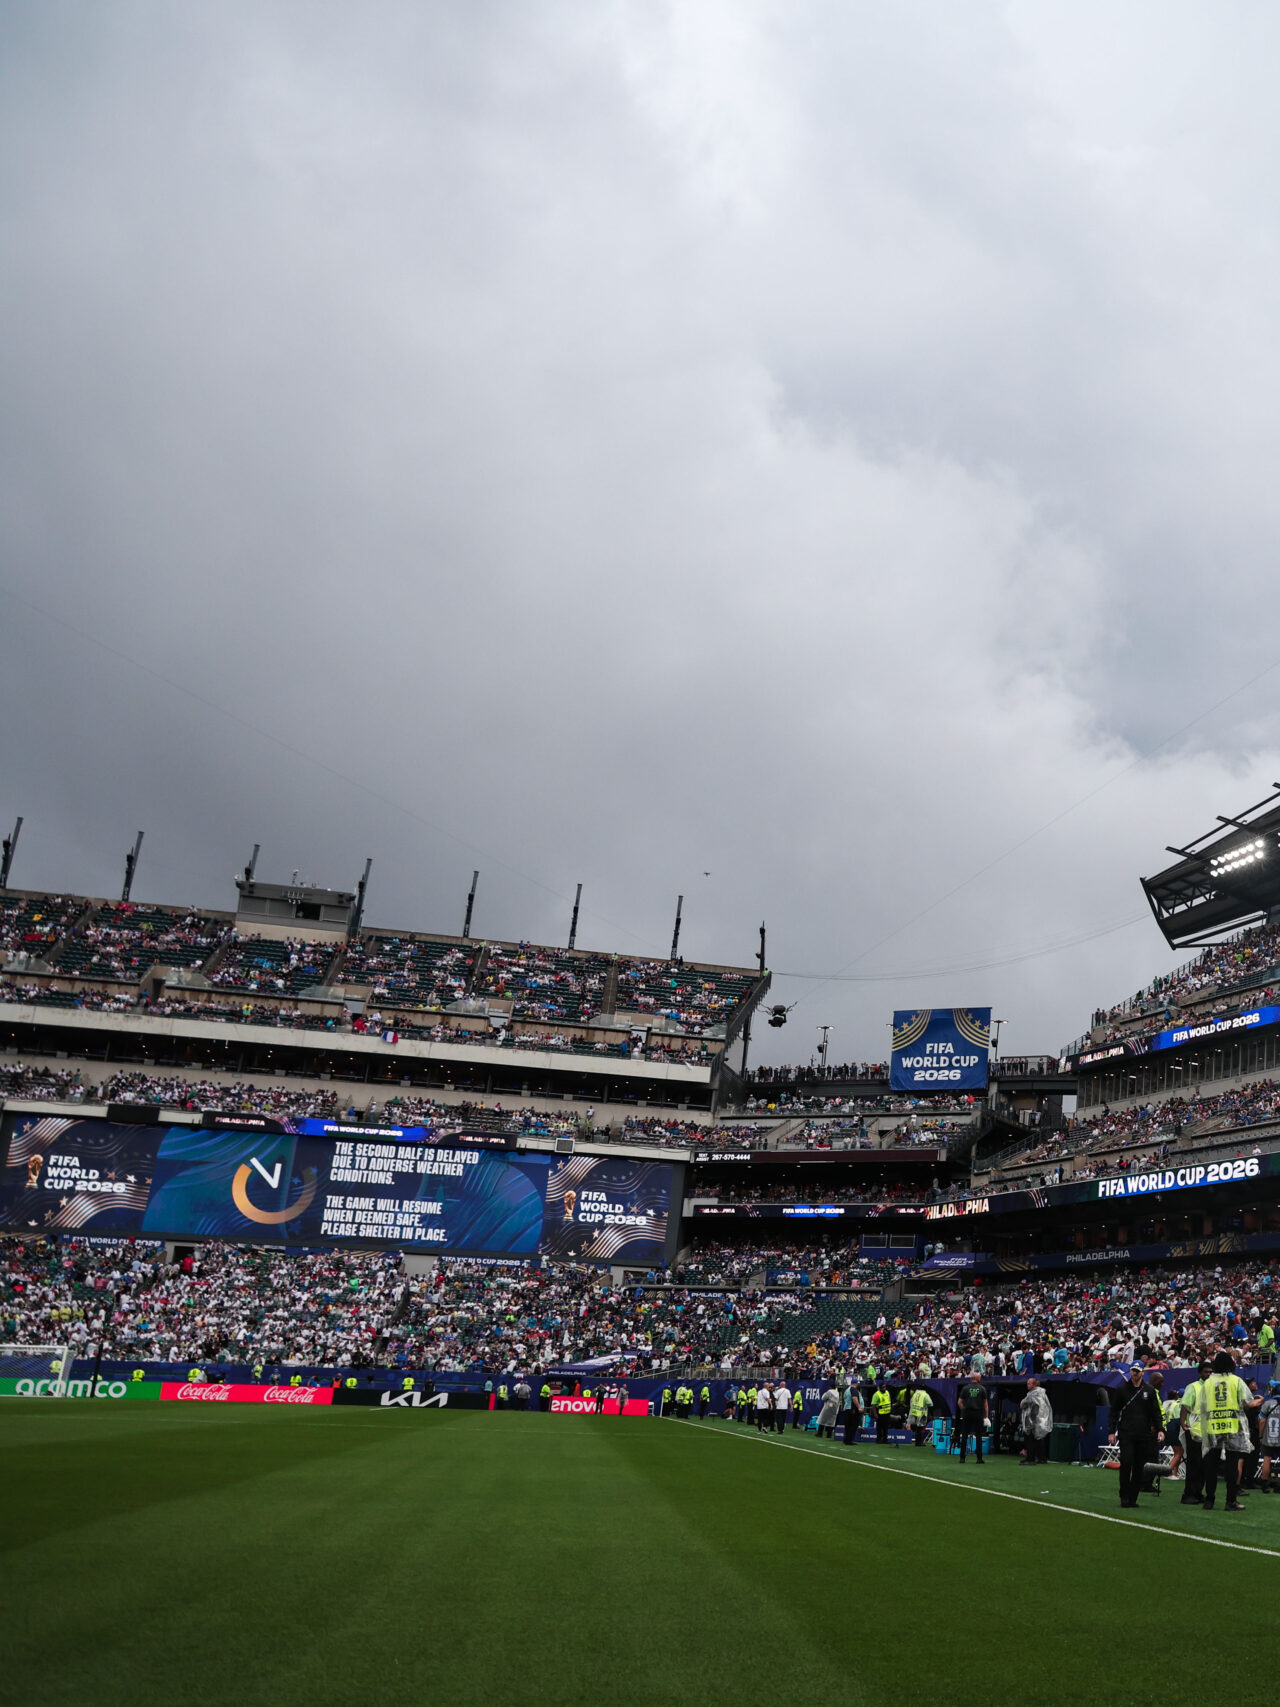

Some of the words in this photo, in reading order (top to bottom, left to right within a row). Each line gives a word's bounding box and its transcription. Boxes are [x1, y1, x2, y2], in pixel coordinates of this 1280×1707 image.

[1173, 1030, 1189, 1042] FIFA
[1189, 1024, 1215, 1039] WORLD
[1216, 1021, 1232, 1033] CUP
[1232, 1013, 1260, 1028] 2026
[925, 1042, 954, 1054] FIFA
[901, 1056, 950, 1068] WORLD
[952, 1055, 979, 1067] CUP
[913, 1069, 961, 1081] 2026
[340, 1126, 363, 1134] WORLD
[458, 1135, 505, 1144] PHILADPHIA
[335, 1142, 354, 1155] THE
[355, 1144, 396, 1158] SECOND
[397, 1146, 423, 1160] HALF
[424, 1148, 434, 1161] IS
[436, 1149, 480, 1164] DELAYED
[49, 1155, 80, 1167] FIFA
[332, 1155, 352, 1168] DUE
[354, 1156, 367, 1169] TO
[368, 1157, 416, 1173] ADVERSE
[416, 1161, 464, 1176] WEATHER
[47, 1167, 99, 1179] WORLD
[330, 1168, 395, 1185] CONDITIONS.
[1098, 1178, 1125, 1197] FIFA
[1126, 1170, 1175, 1194] WORLD
[1176, 1166, 1205, 1187] CUP
[1207, 1158, 1260, 1182] 2026
[44, 1178, 74, 1190] CUP
[74, 1181, 126, 1193] 2026
[581, 1191, 607, 1202] FIFA
[326, 1195, 345, 1208] THE
[345, 1196, 376, 1210] GAME
[376, 1198, 400, 1212] WILL
[402, 1200, 443, 1215] RESUME
[579, 1202, 624, 1213] WORLD
[323, 1208, 353, 1222] WHEN
[354, 1210, 395, 1225] DEEMED
[395, 1213, 423, 1227] SAFE.
[578, 1213, 604, 1223] CUP
[604, 1214, 647, 1226] 2026
[320, 1222, 358, 1237] PLEASE
[358, 1224, 400, 1239] SHELTER
[401, 1226, 413, 1240] IN
[414, 1228, 448, 1242] PLACE.
[90, 1237, 117, 1245] WORLD
[1066, 1250, 1130, 1263] PHILADELPHIA
[15, 1378, 127, 1398] aramco
[806, 1388, 821, 1400] FIFA
